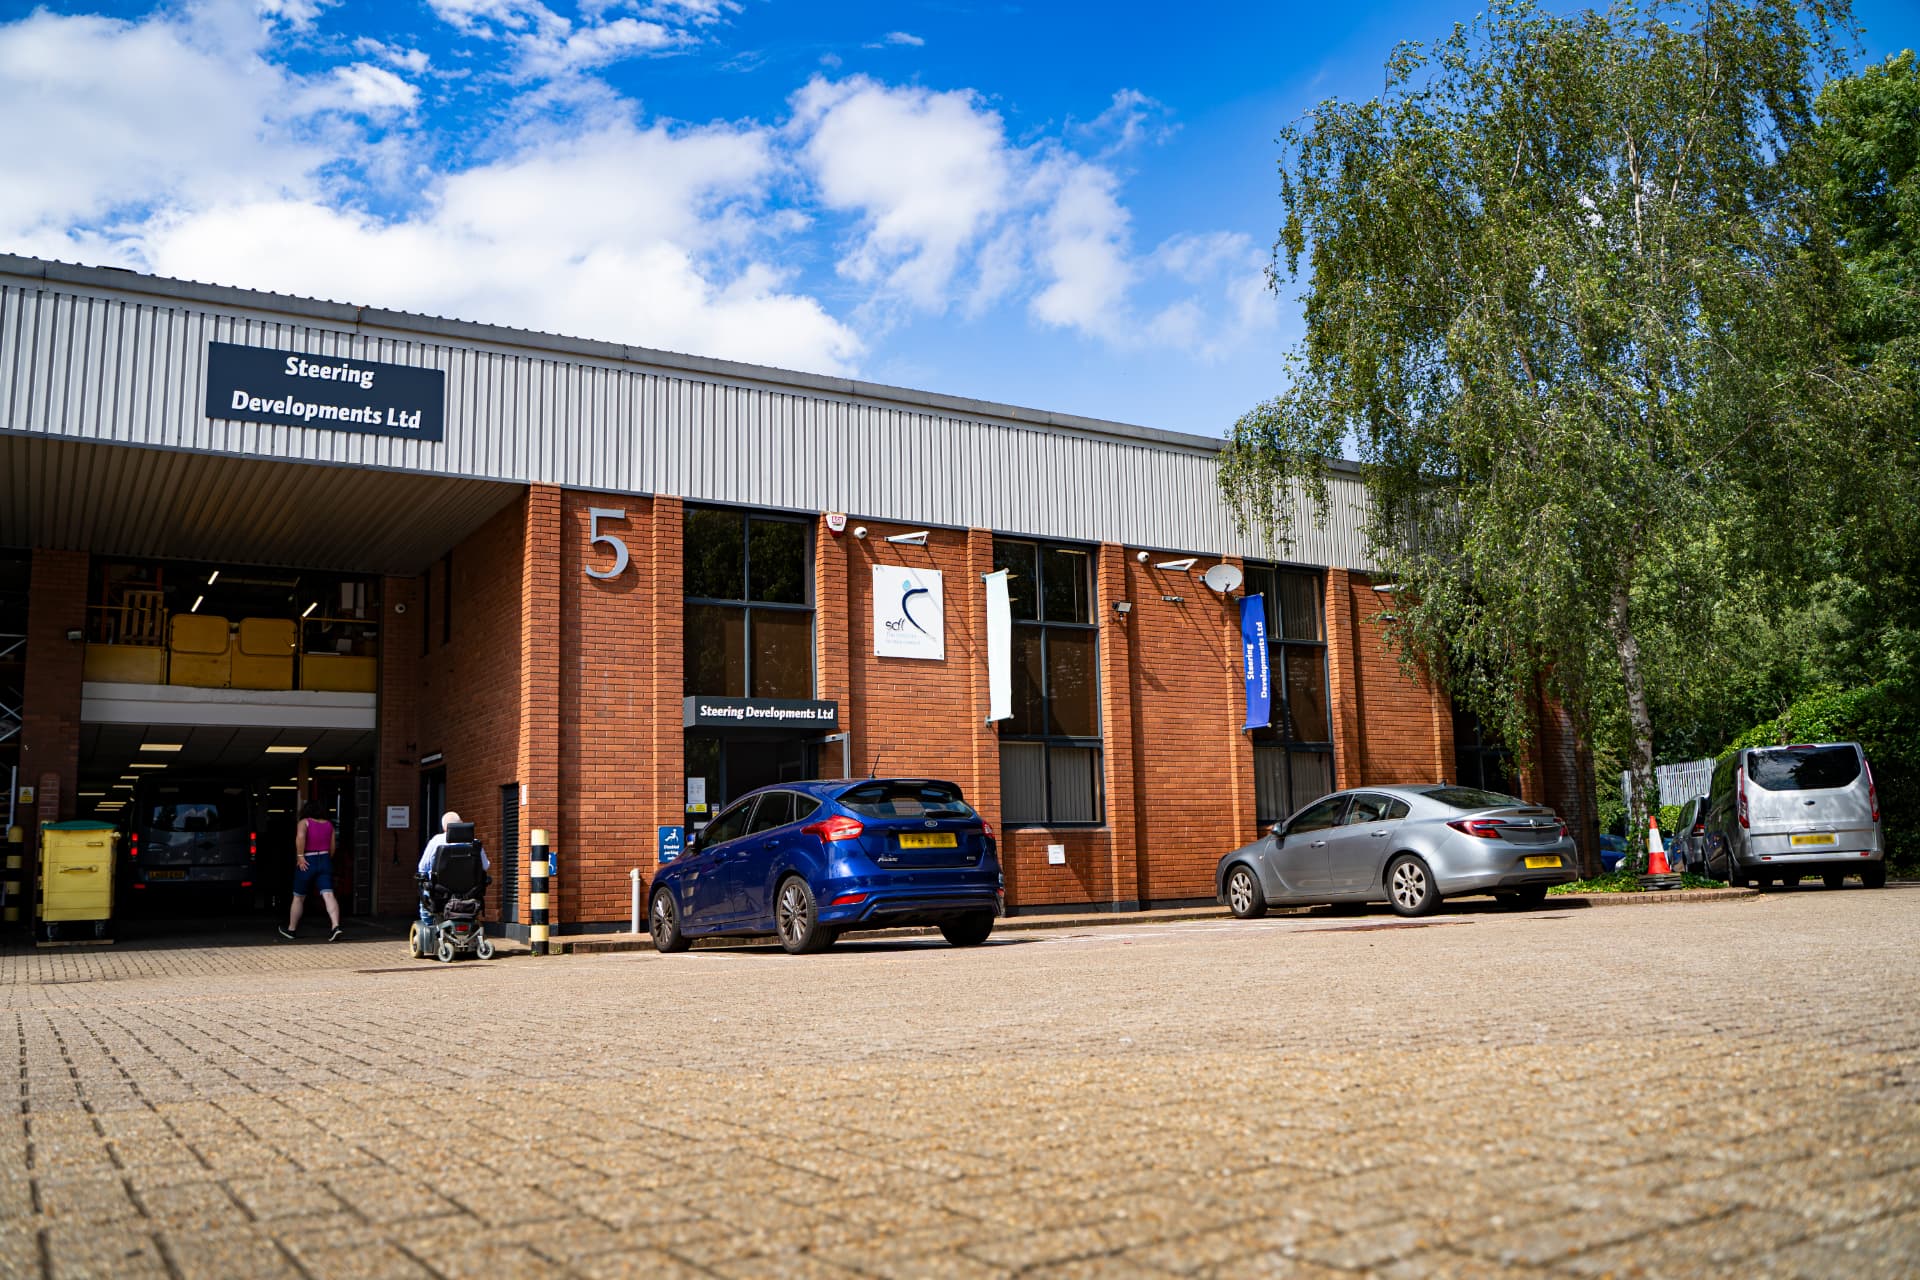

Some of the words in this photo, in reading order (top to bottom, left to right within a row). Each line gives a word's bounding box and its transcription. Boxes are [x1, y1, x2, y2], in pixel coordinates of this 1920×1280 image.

[285, 356, 375, 389] Steering
[231, 390, 382, 424] Developments
[386, 407, 422, 429] Ltd
[585, 506, 629, 579] 5
[1255, 621, 1264, 636] Ltd
[1246, 643, 1255, 680] Steering
[1258, 637, 1269, 698] Developments
[700, 705, 744, 719] Steering
[745, 706, 816, 720] Developments
[817, 708, 834, 719] Ltd
